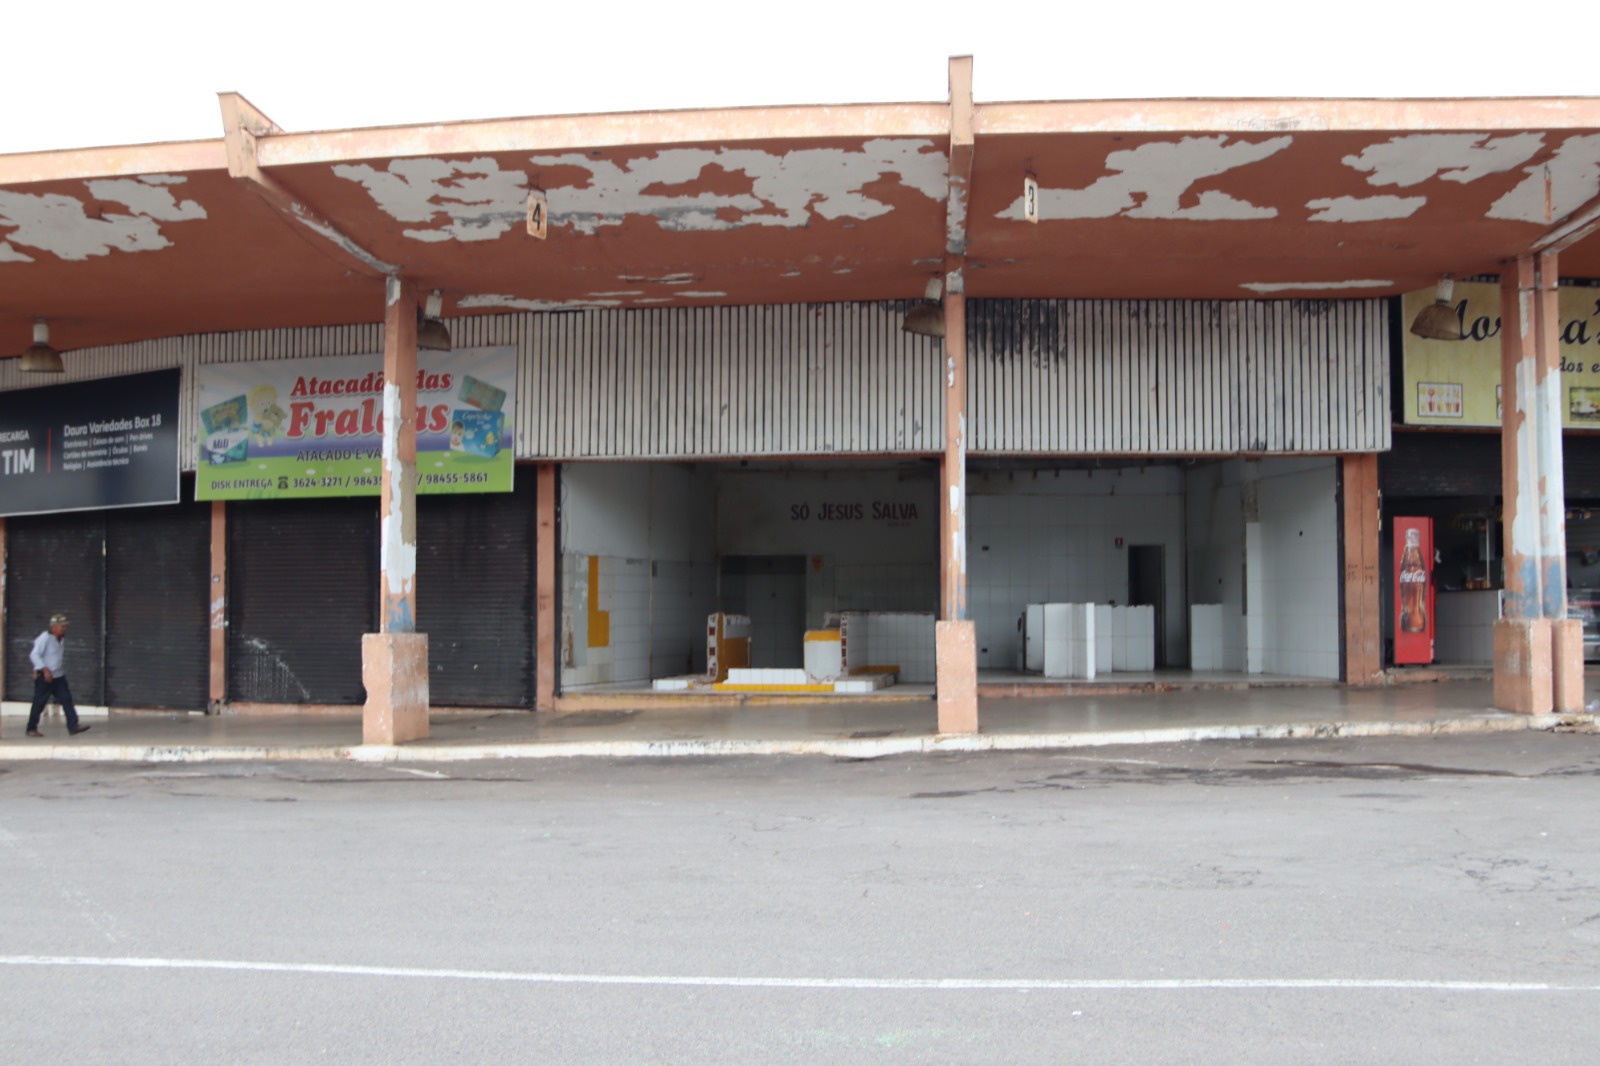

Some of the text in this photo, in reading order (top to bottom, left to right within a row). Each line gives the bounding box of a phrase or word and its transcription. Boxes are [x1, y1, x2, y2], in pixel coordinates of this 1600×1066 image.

[1028, 185, 1035, 216] 3
[532, 202, 541, 231] 4
[290, 370, 384, 397] Atacadã
[89, 417, 133, 434] Variedades
[134, 416, 150, 429] Box
[151, 413, 162, 427] 18
[2, 447, 35, 475] TIM
[296, 449, 352, 462] ATACADO
[355, 449, 362, 460] E
[211, 480, 231, 490] DISK
[817, 502, 864, 521] JESUS
[872, 500, 919, 520] SALVA
